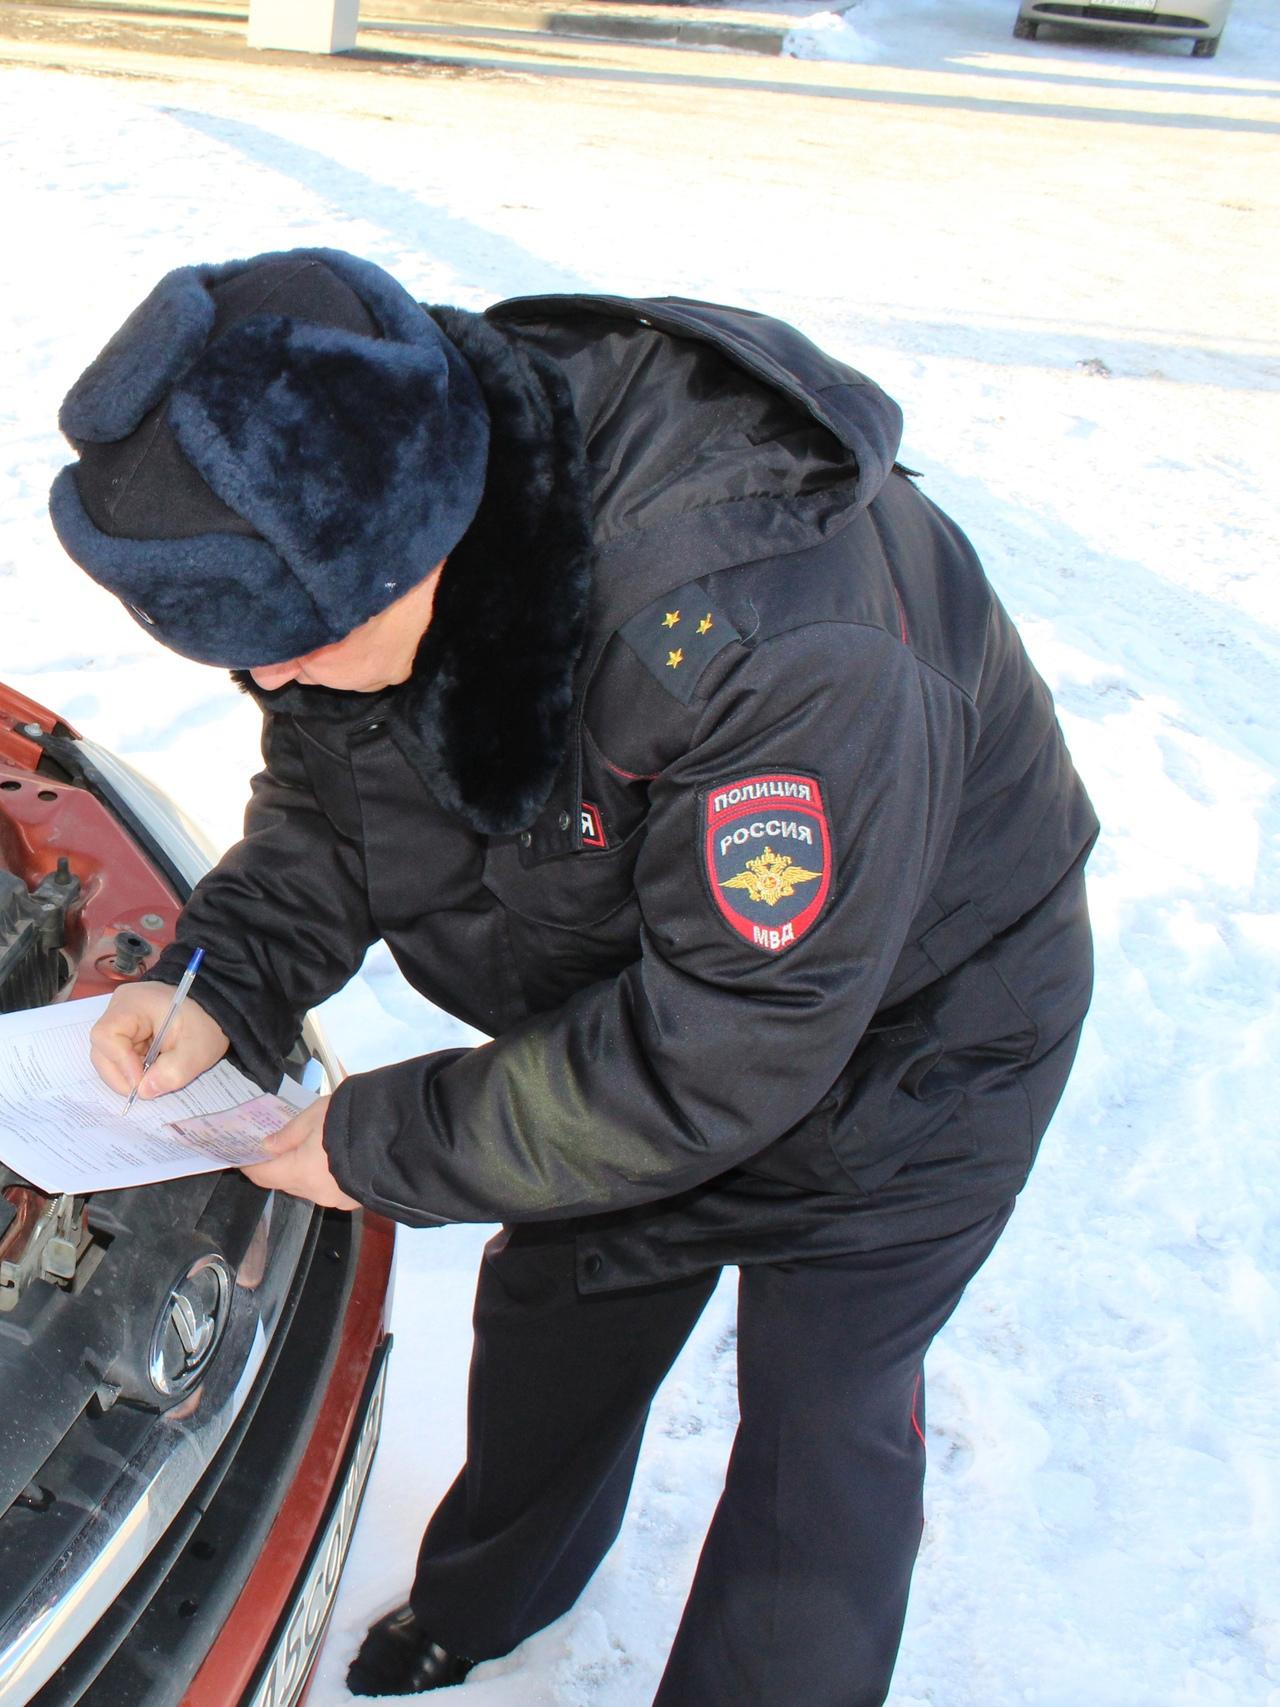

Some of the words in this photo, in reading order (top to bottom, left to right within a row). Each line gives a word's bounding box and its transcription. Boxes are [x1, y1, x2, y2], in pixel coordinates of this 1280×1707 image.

[714, 781, 811, 812] ПОЛИЦИЯ
[720, 820, 813, 856] РОССИЯ
[753, 922, 795, 949] МВД
